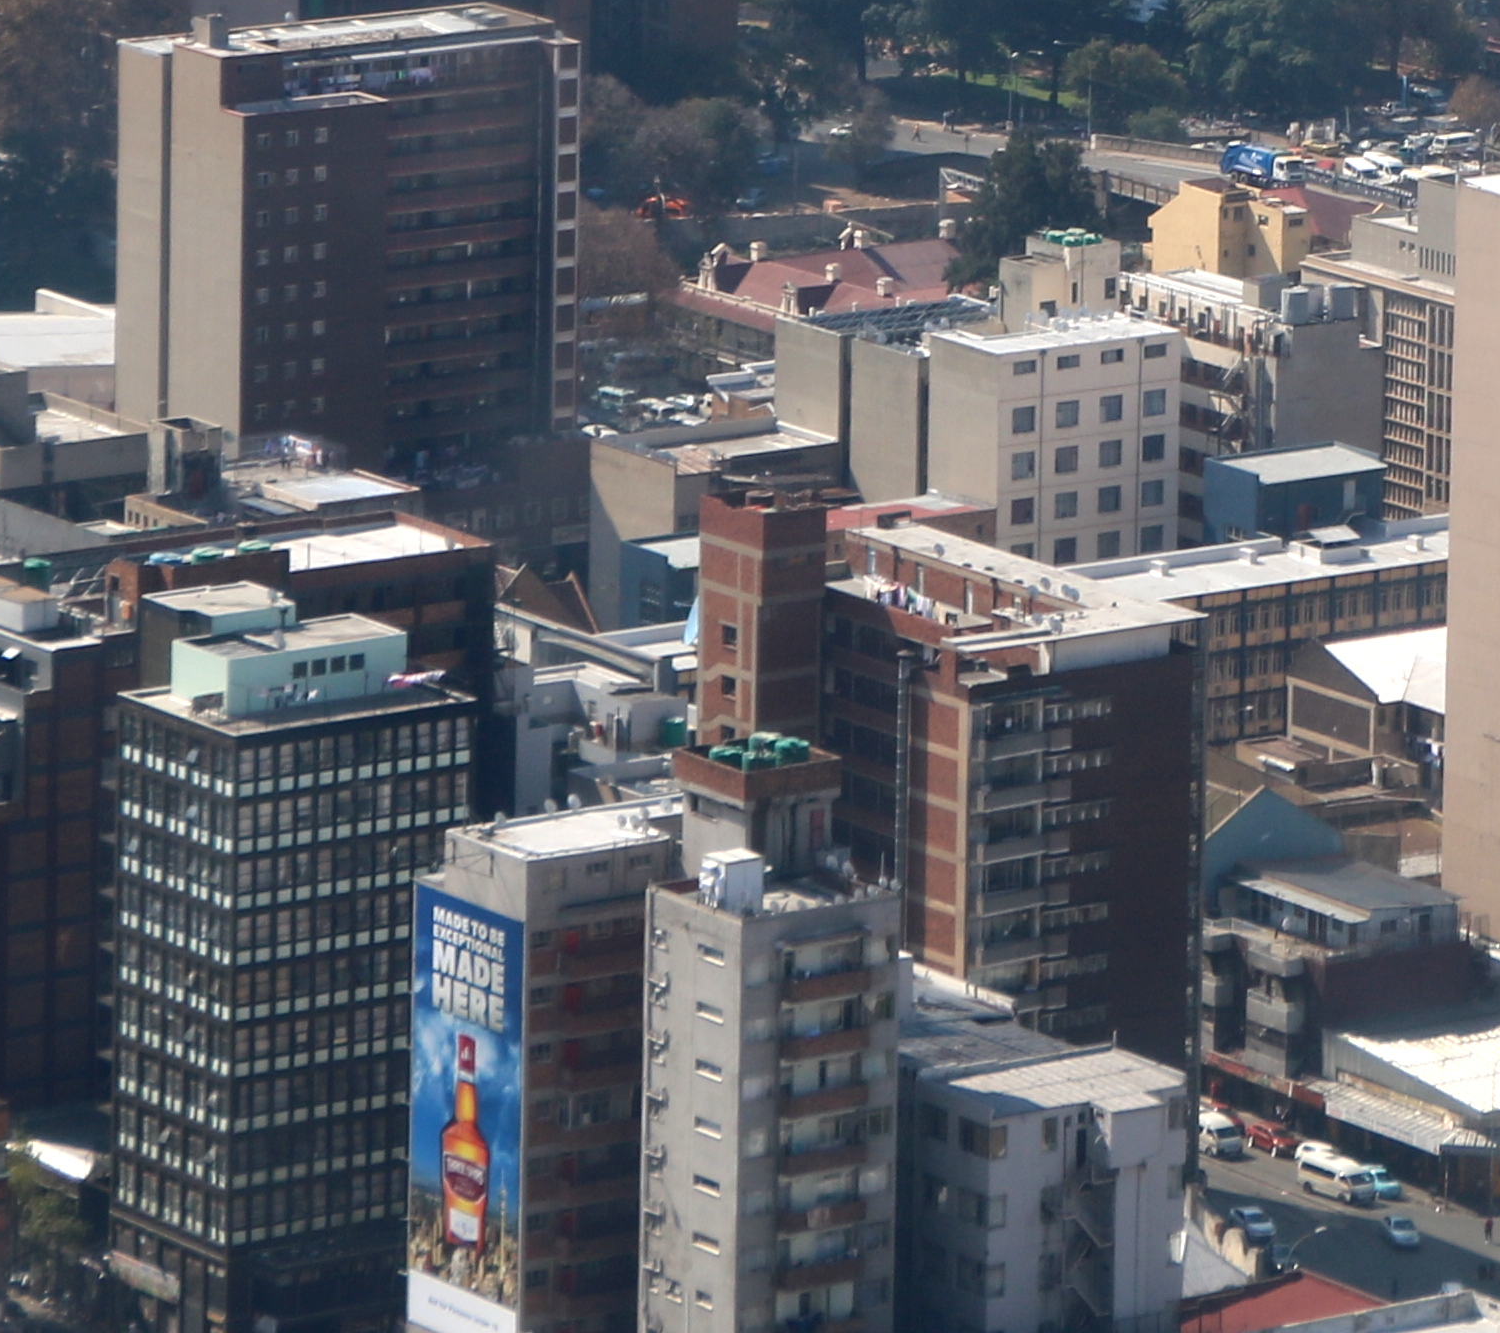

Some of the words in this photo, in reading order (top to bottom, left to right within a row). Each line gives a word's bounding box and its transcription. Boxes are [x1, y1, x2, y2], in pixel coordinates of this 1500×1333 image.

[433, 906, 470, 933] MADE
[470, 920, 488, 940] TO
[489, 927, 505, 947] BE
[433, 924, 505, 962] EXCEPTIONAL
[432, 939, 505, 995] MADE
[432, 972, 504, 1033] HERE
